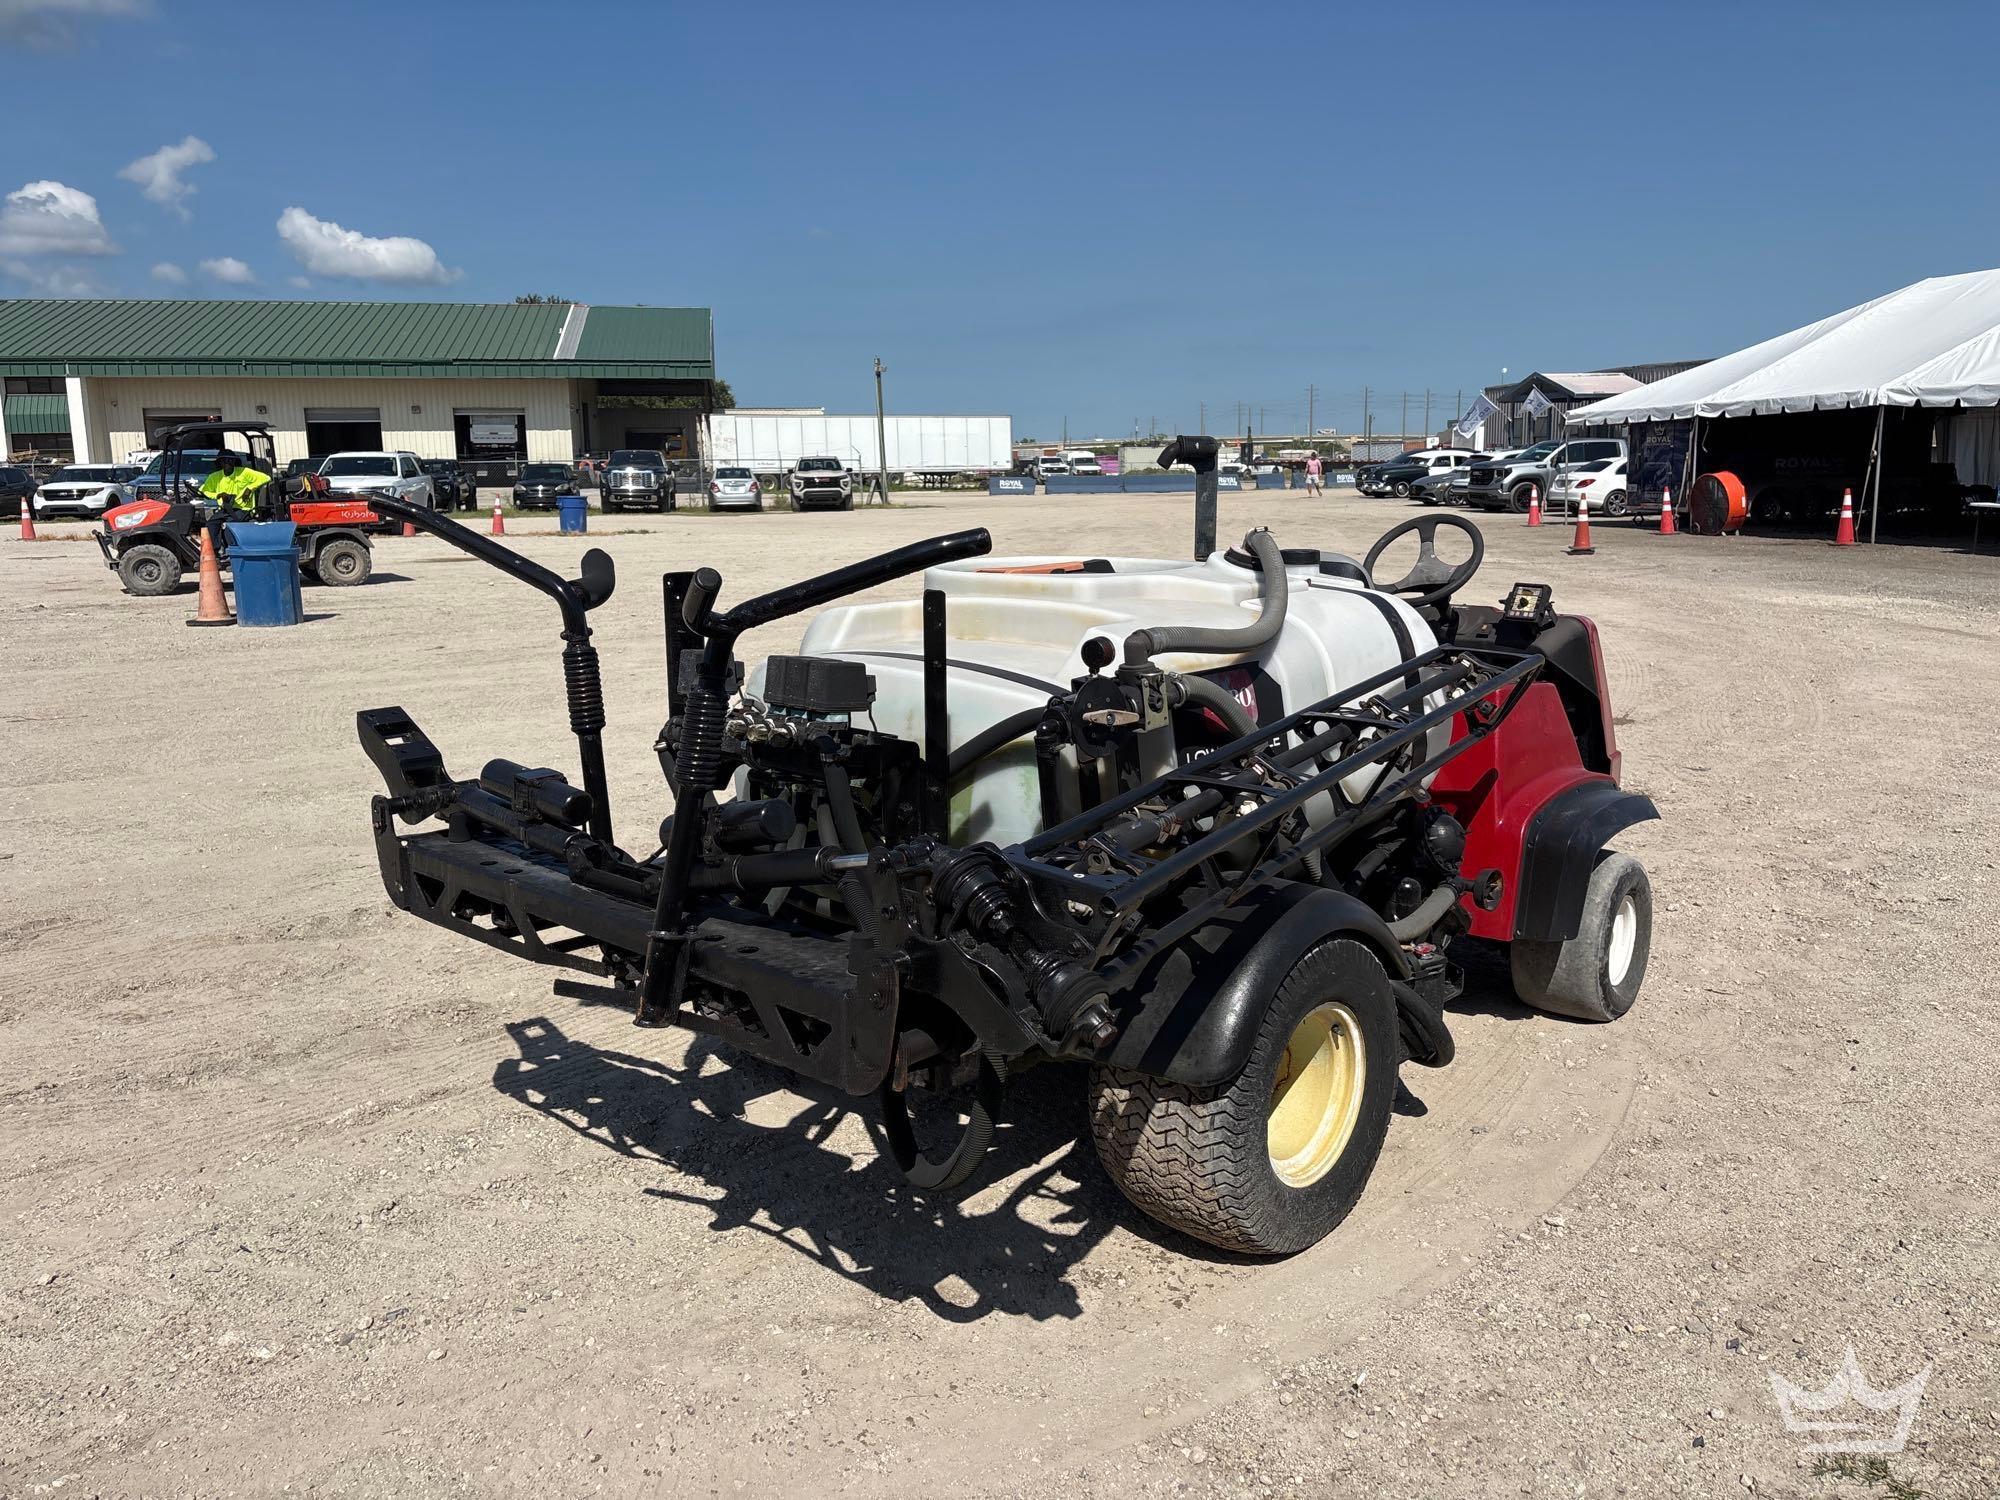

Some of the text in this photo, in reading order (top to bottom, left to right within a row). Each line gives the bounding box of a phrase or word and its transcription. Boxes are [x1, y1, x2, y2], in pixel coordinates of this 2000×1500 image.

[1646, 436, 1671, 444] ROYAL
[1775, 457, 1832, 468] ROYAL
[999, 479, 1023, 487] ROYAL
[341, 511, 375, 519] Kubota
